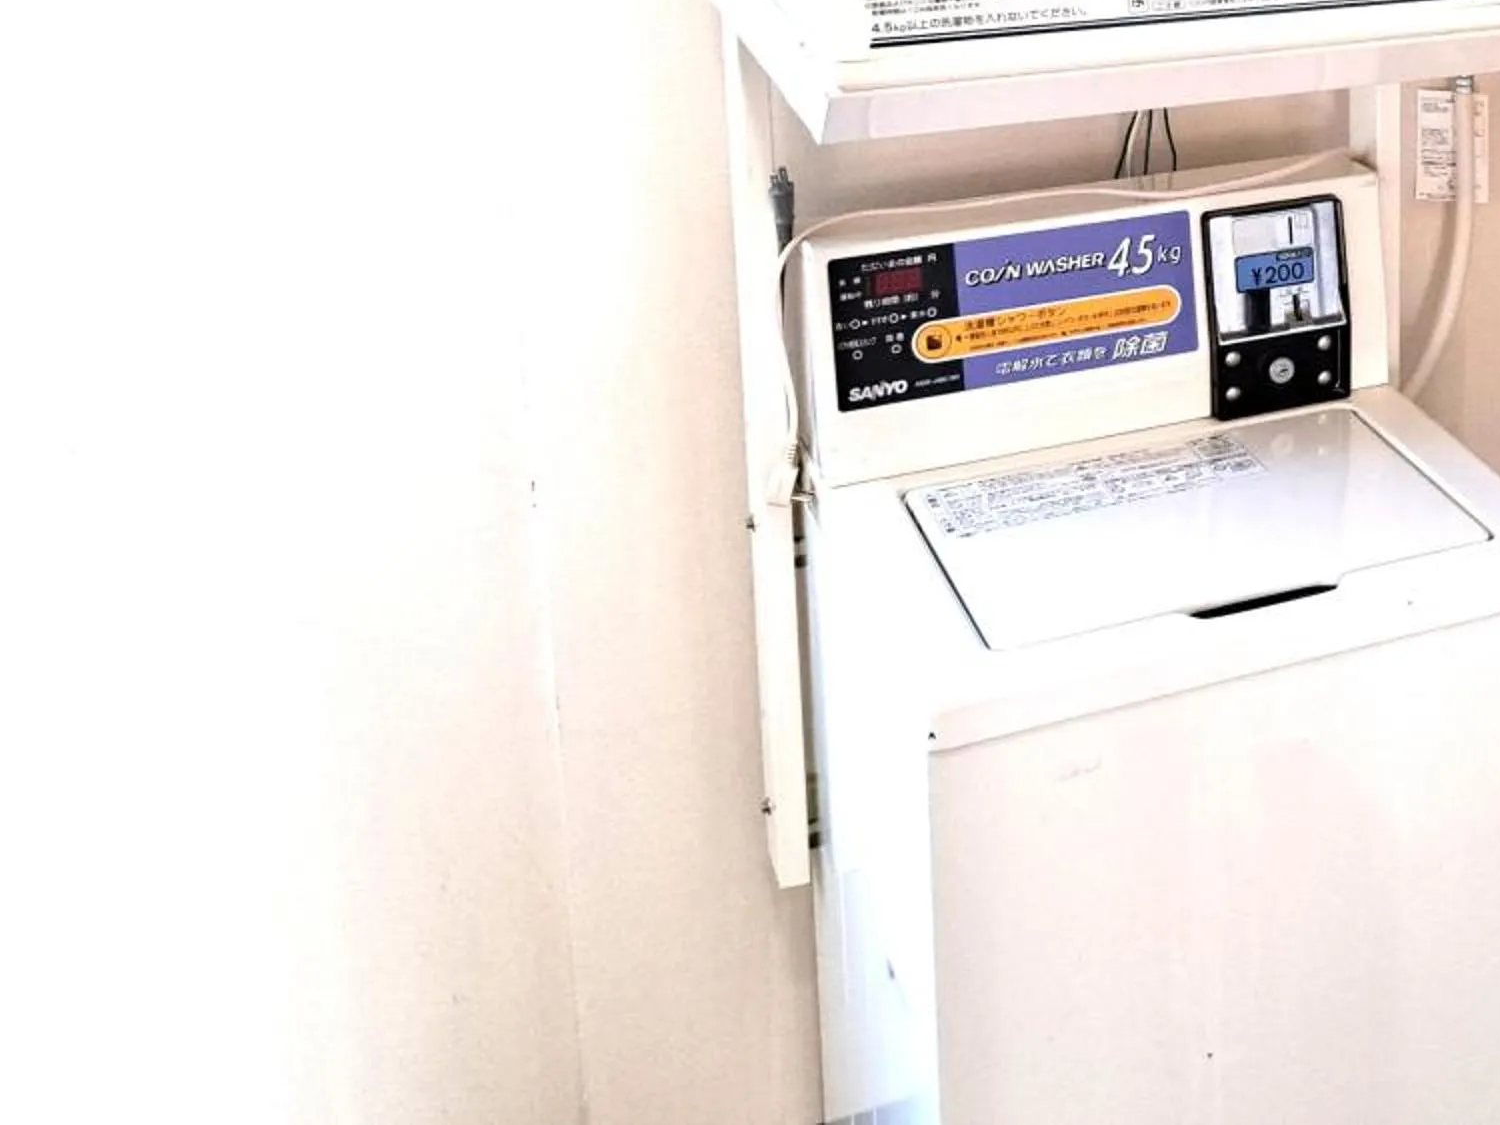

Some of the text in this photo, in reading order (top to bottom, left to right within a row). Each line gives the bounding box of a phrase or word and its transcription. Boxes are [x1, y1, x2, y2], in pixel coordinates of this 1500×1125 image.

[1026, 252, 1105, 275] WASHER
[1157, 245, 1181, 264] kg
[1251, 262, 1305, 286] ¥200
[1112, 331, 1168, 360] 除菌
[848, 380, 908, 402] SANYO
